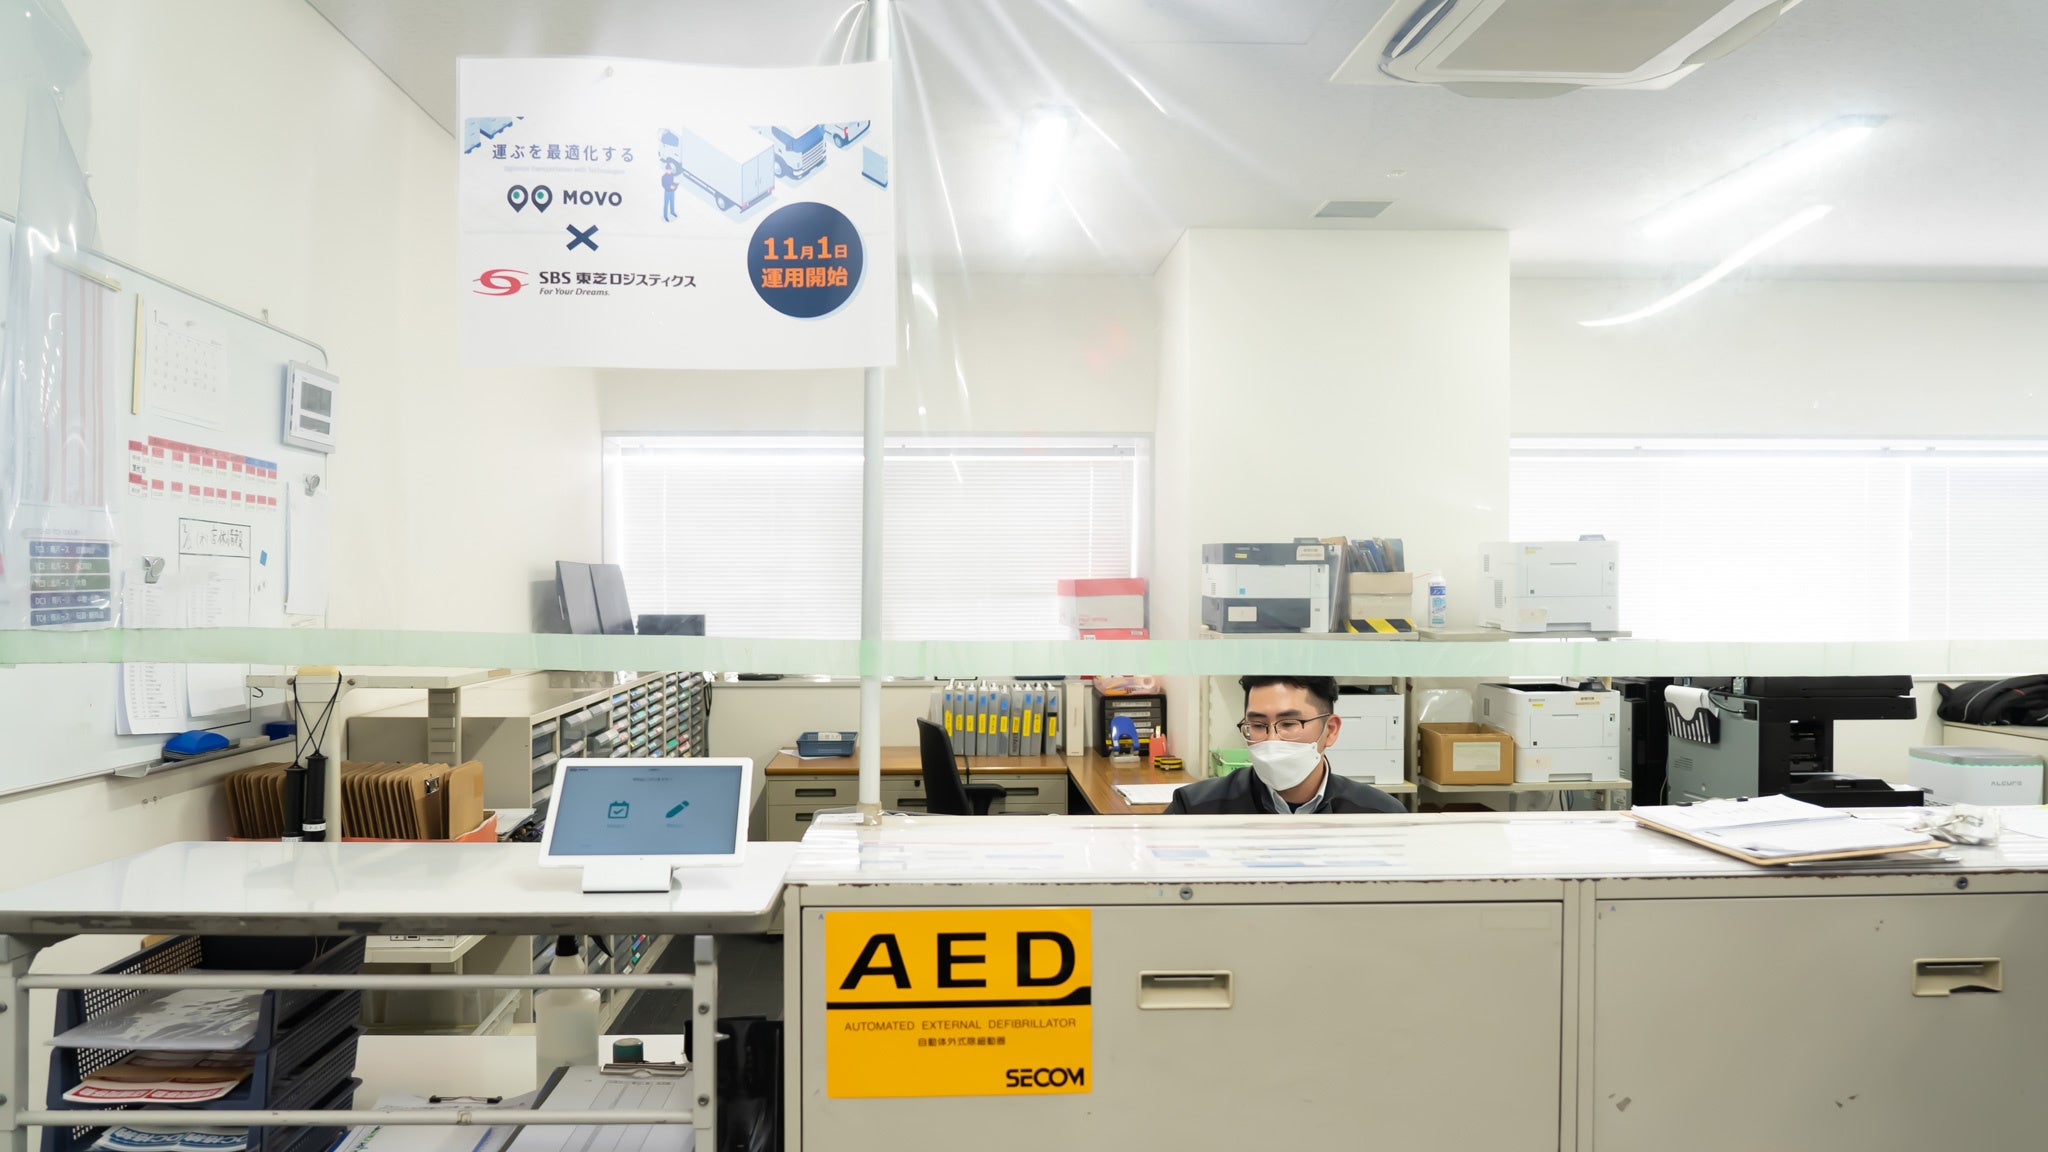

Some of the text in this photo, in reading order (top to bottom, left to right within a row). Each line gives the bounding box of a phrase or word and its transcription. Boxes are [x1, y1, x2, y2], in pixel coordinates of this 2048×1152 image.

[492, 143, 634, 163] 運ぶを最適化する
[563, 189, 623, 207] MOVO
[763, 236, 848, 260] 11月1日
[539, 271, 697, 288] SBS 東芝ロジスティクス
[761, 265, 849, 288] 運用開始
[539, 287, 610, 296] For Your Dreams.
[839, 931, 1076, 990] AED
[844, 1018, 1077, 1032] AUTOMATED EXTERNAL DEFIBRILLATOR
[917, 1036, 1006, 1047] 自動体外式除細動器
[1005, 1067, 1085, 1088] SECOM
